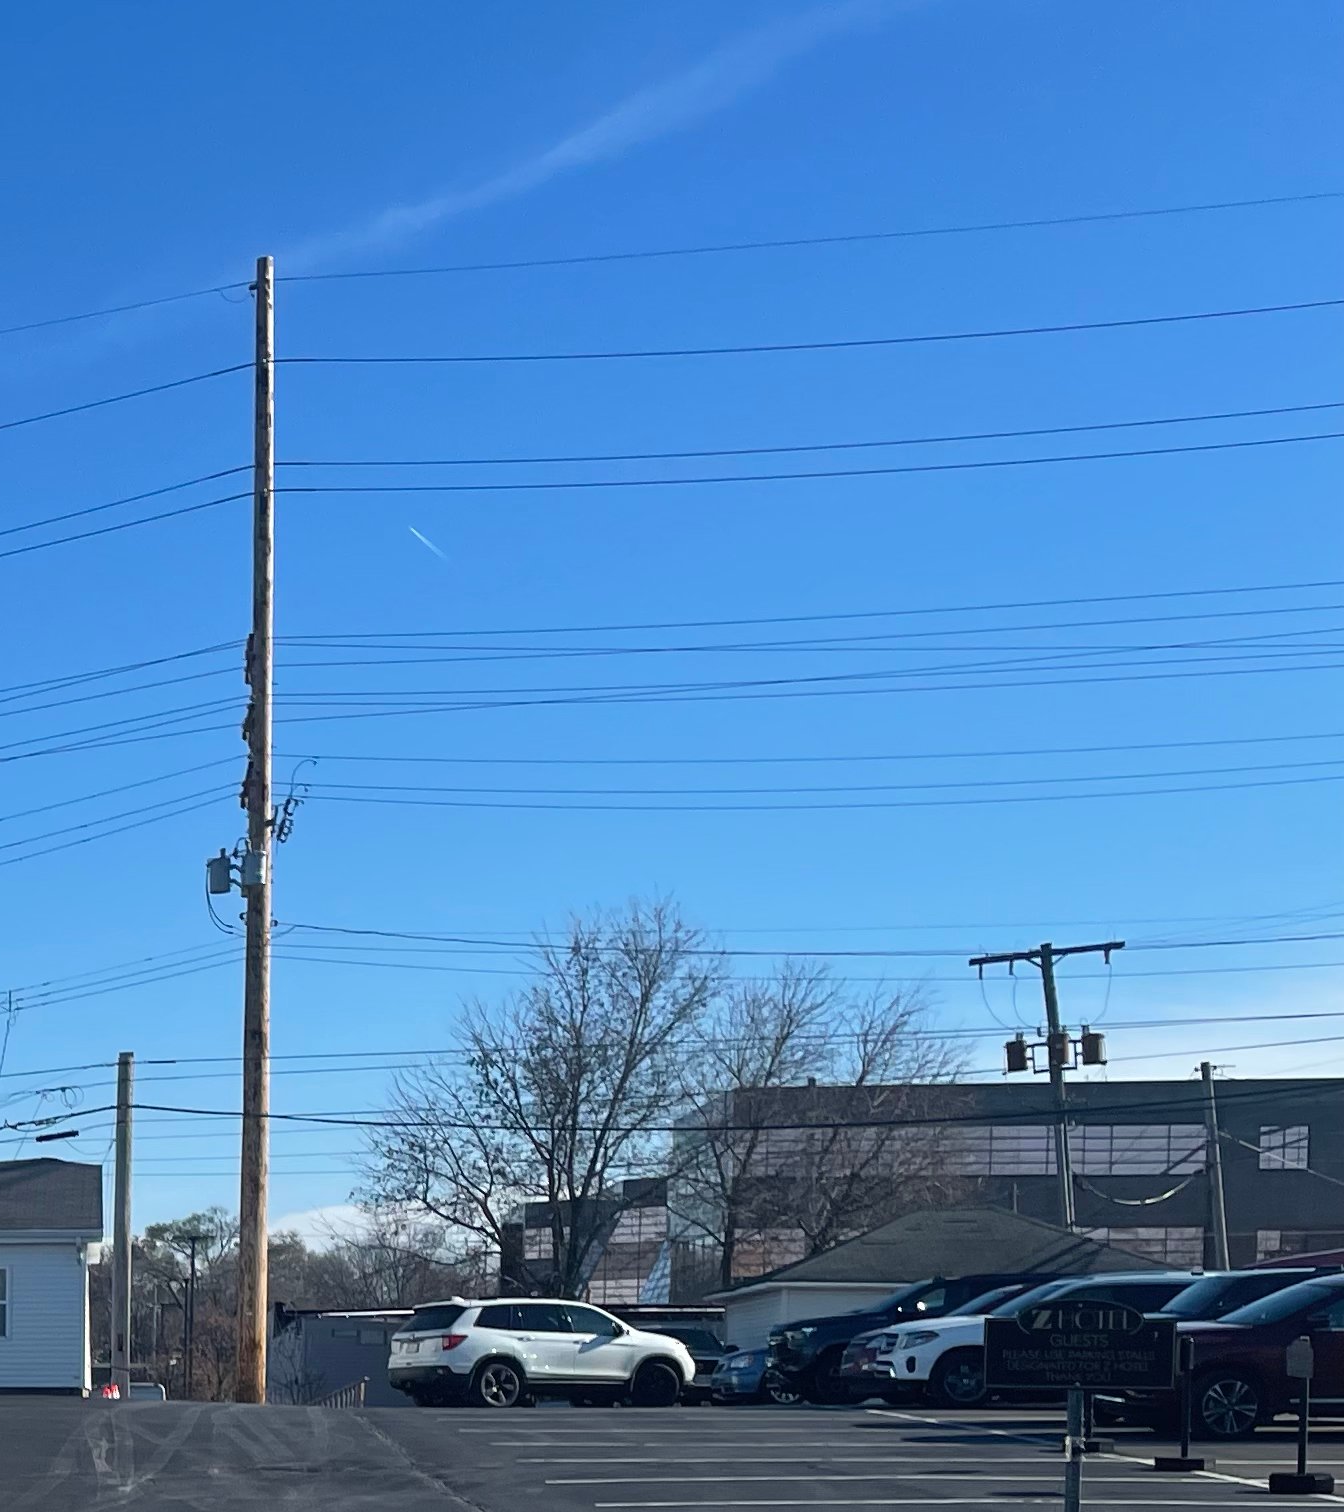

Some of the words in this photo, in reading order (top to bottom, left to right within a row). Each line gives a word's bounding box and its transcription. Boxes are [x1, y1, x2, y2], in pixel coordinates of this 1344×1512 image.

[1032, 1309, 1052, 1330] Z
[1058, 1309, 1132, 1330] HOTEL
[1049, 1334, 1110, 1347] GUESTS
